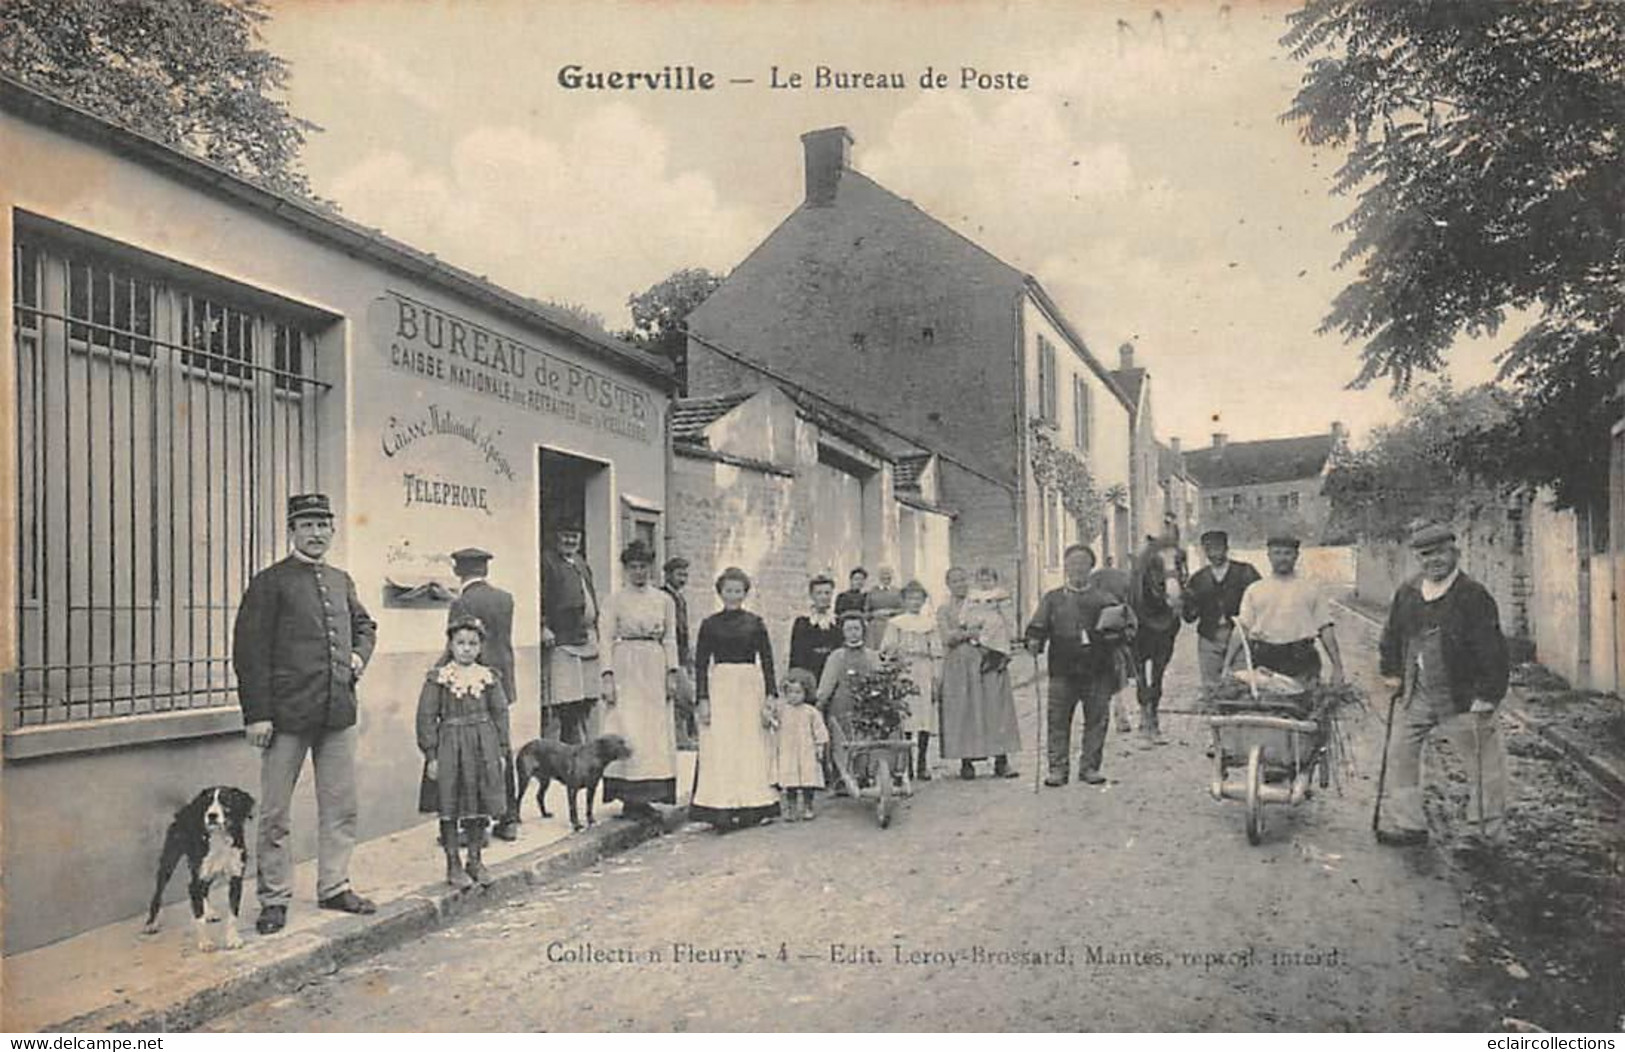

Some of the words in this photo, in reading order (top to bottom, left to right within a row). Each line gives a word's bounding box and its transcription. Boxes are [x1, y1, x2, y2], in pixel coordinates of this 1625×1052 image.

[391, 343, 445, 380] CAISSE
[450, 366, 511, 402] NATIONALE
[396, 300, 526, 379] BUREAU
[534, 358, 560, 394] de
[567, 368, 648, 421] POSTE
